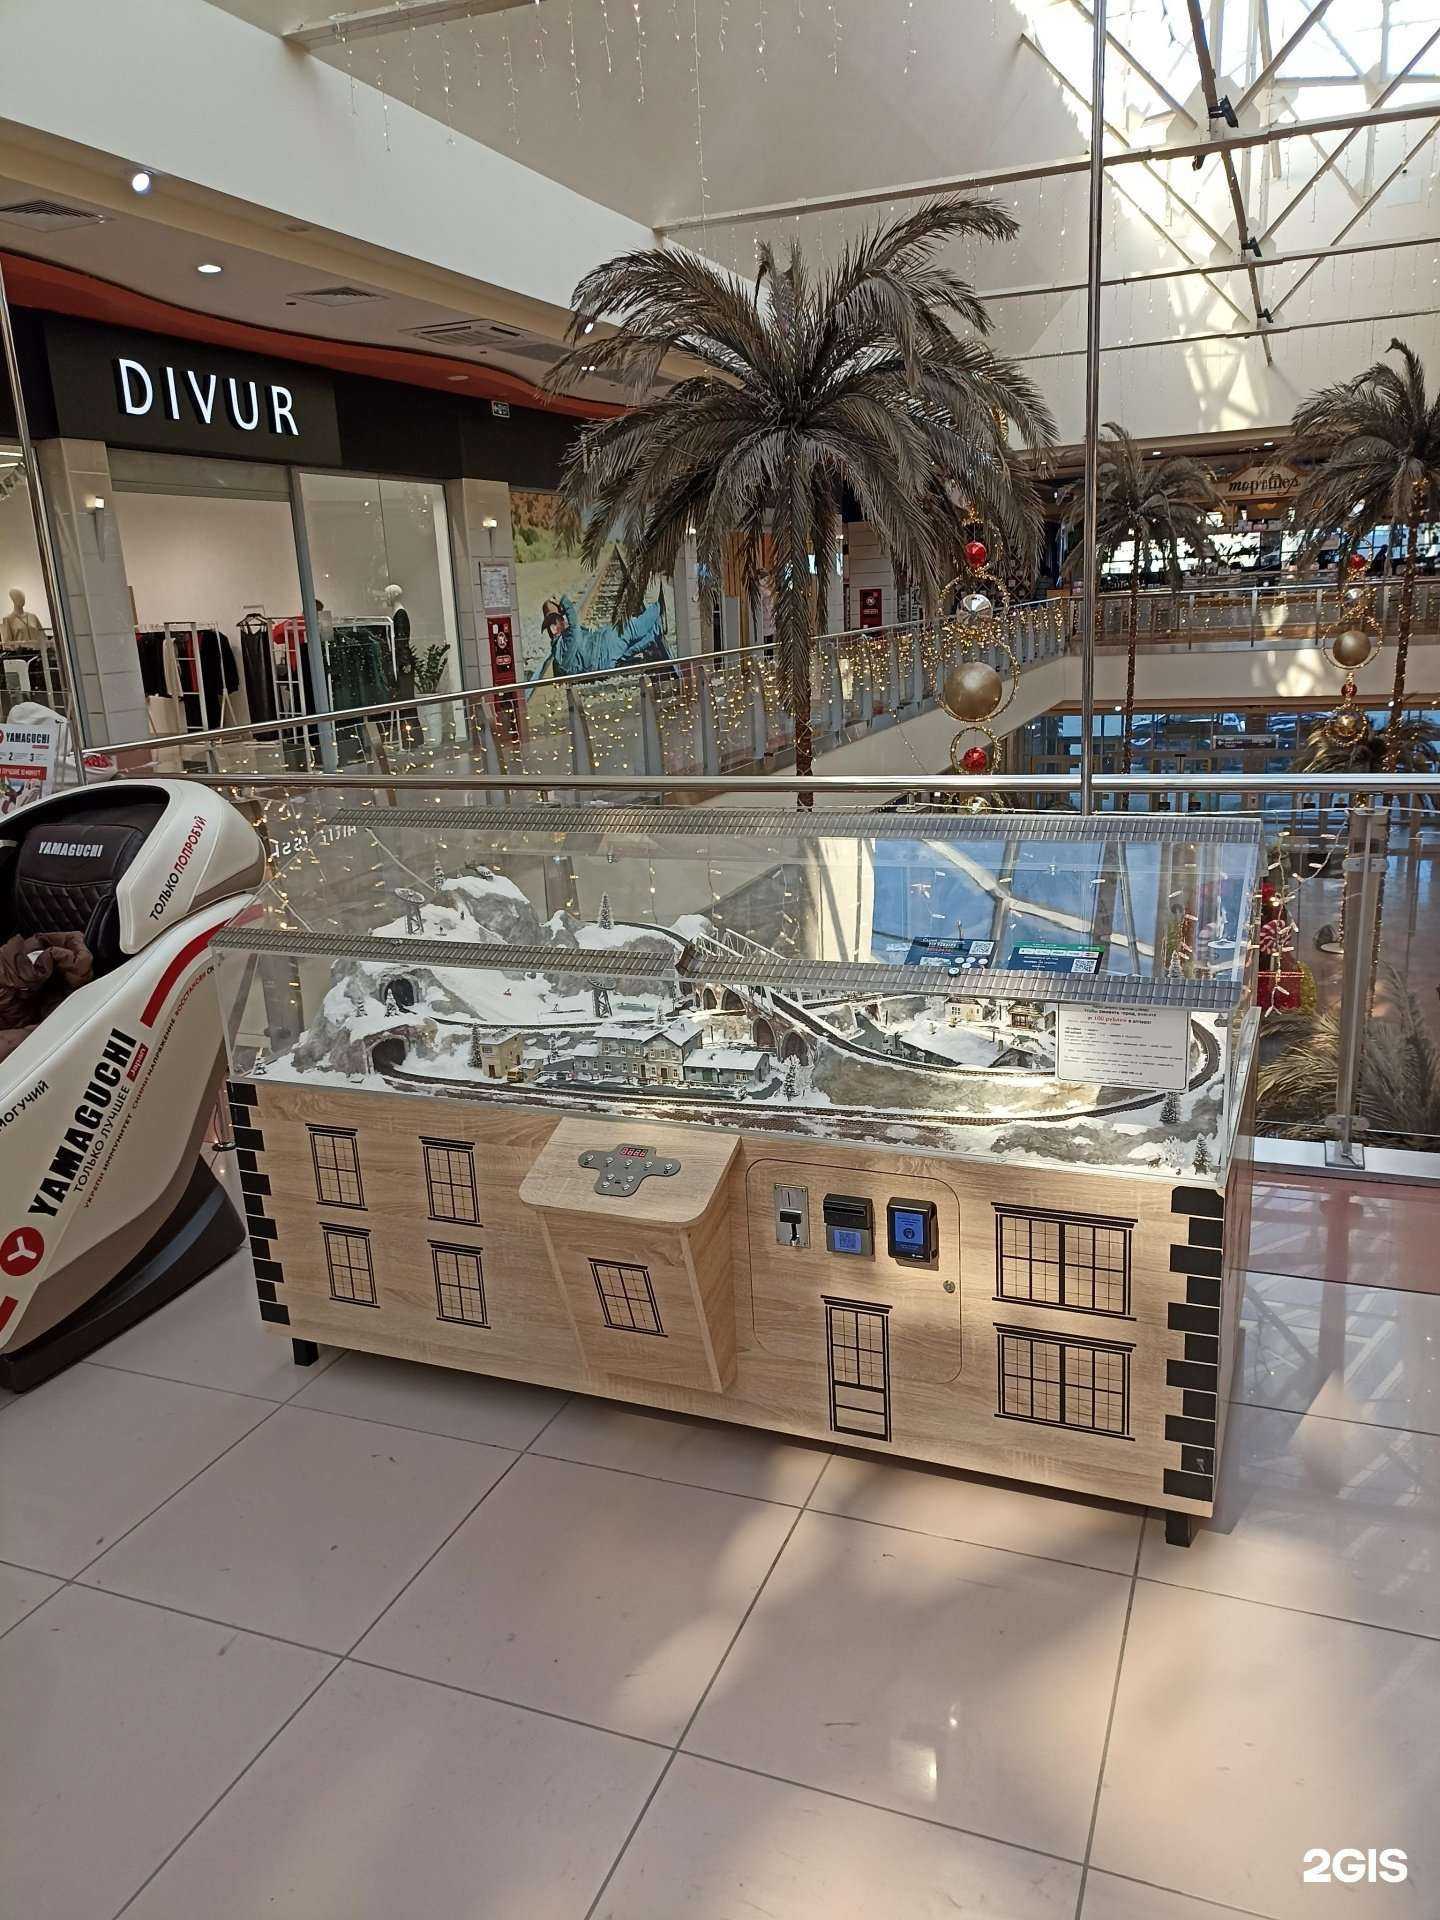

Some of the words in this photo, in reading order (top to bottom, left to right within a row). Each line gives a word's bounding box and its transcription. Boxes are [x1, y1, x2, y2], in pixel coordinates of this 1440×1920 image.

[116, 357, 300, 437] DIVUR
[6, 731, 50, 744] YAMAGUCHI
[38, 841, 104, 857] YAMAGUCHI
[149, 872, 179, 922] ТОЛЬКО
[174, 815, 208, 875] ПОПРОБУЙ
[148, 1017, 177, 1077] НАПРЯЖЕНИЕ
[28, 1028, 137, 1217] YAMAGUCHI
[73, 1138, 105, 1193] ТОЛЬКО
[101, 1085, 130, 1139] ЛУЧШЕЕ
